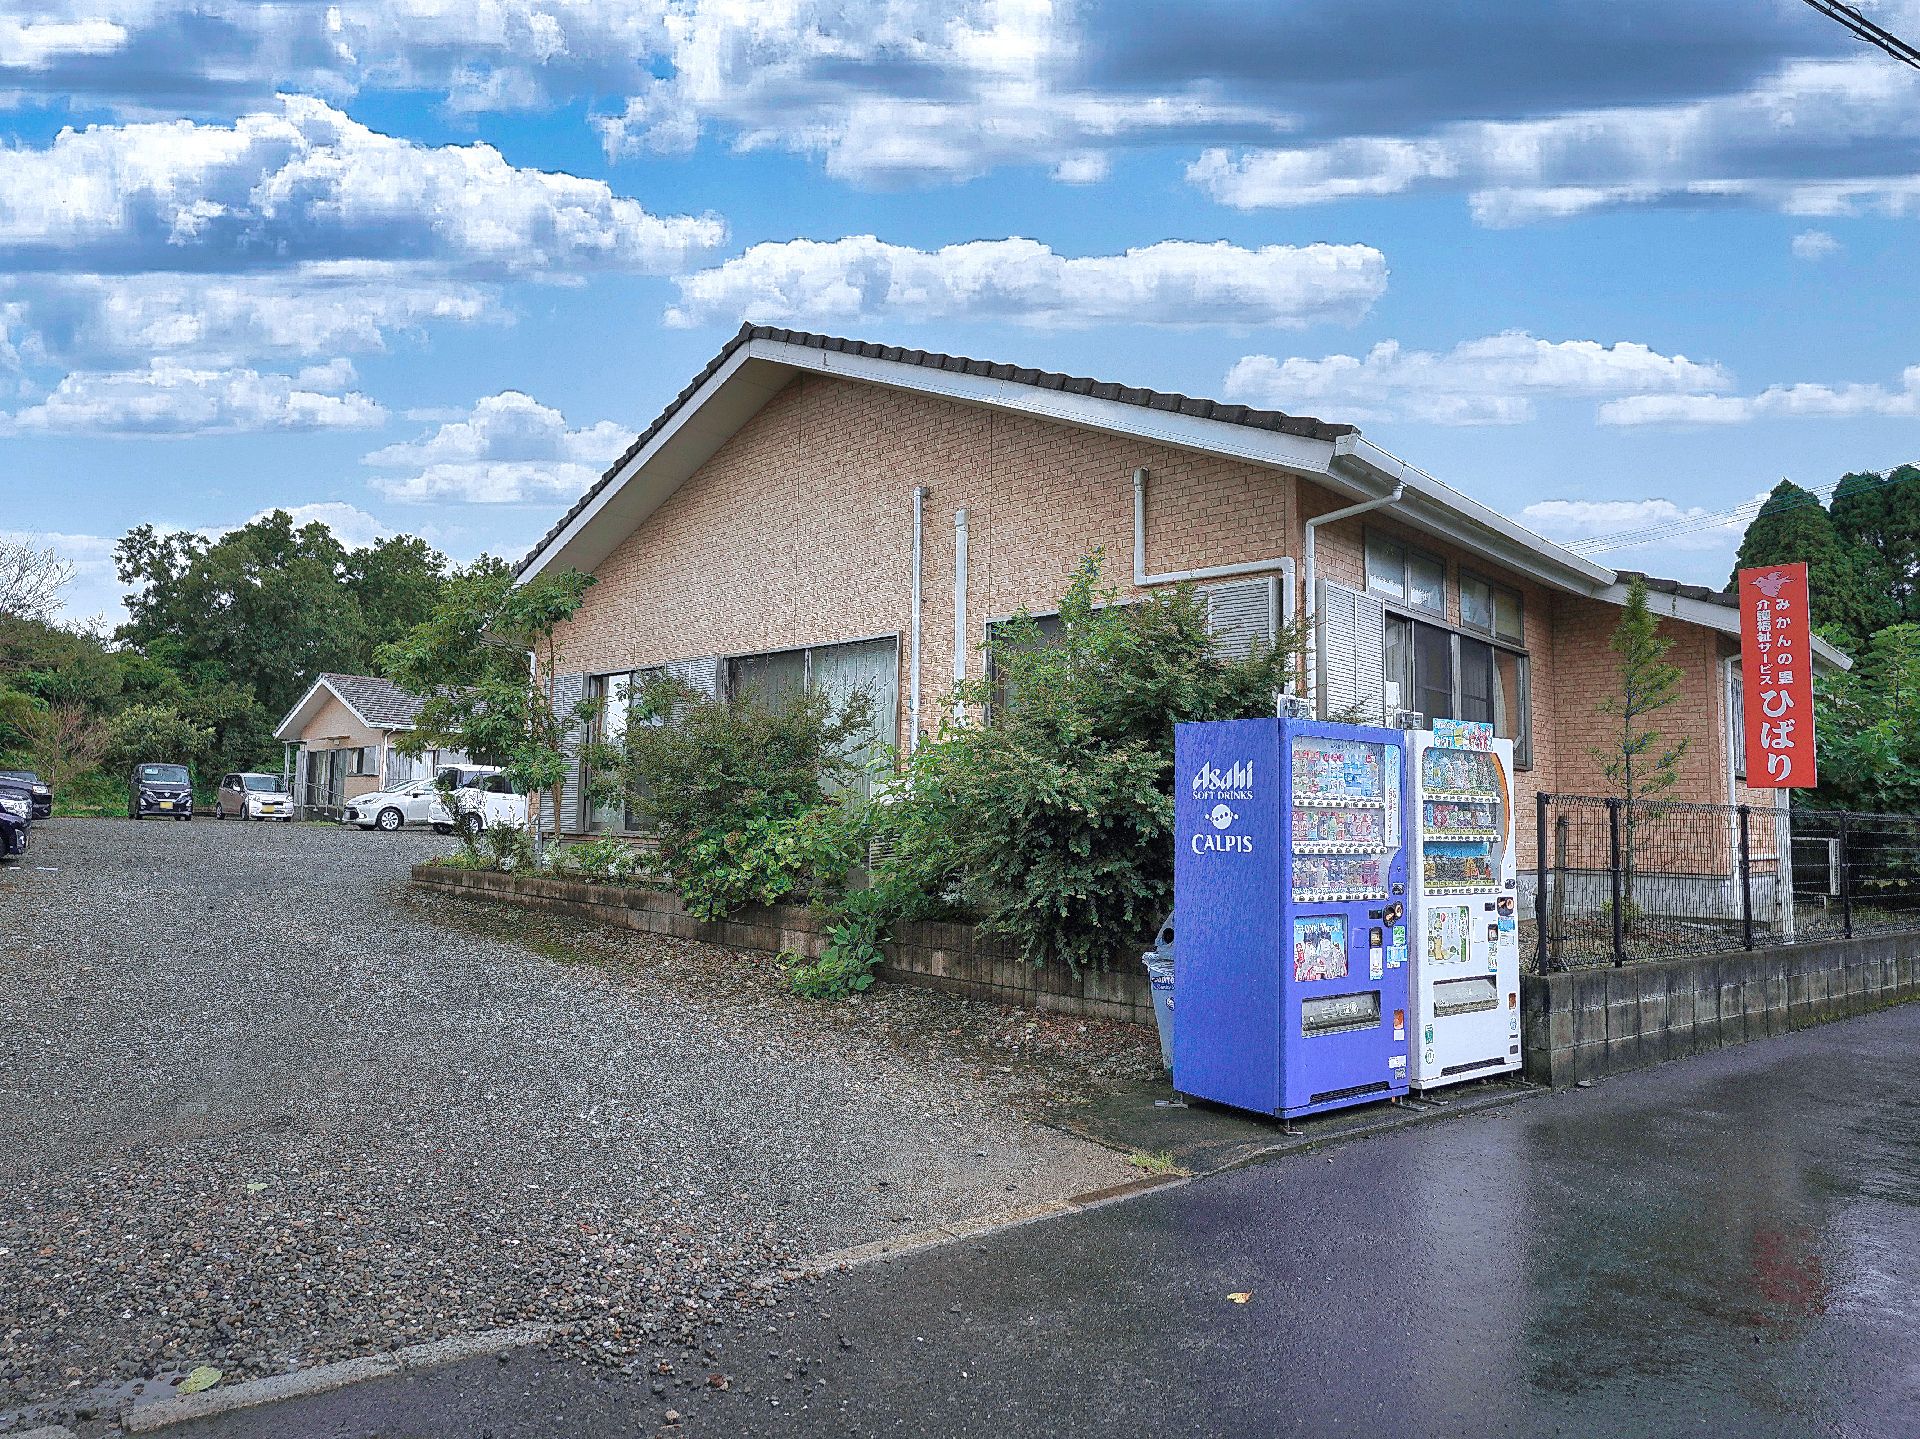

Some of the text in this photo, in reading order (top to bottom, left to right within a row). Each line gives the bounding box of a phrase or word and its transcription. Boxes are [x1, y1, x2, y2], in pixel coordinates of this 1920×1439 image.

[1756, 599, 1774, 686] 介護福祉サービス
[1776, 599, 1794, 685] みかんの里
[1760, 689, 1796, 782] ひばり
[1192, 760, 1253, 790] Asahi
[1192, 790, 1254, 800] SOFT DRINKS
[1191, 833, 1253, 855] CALPIS
